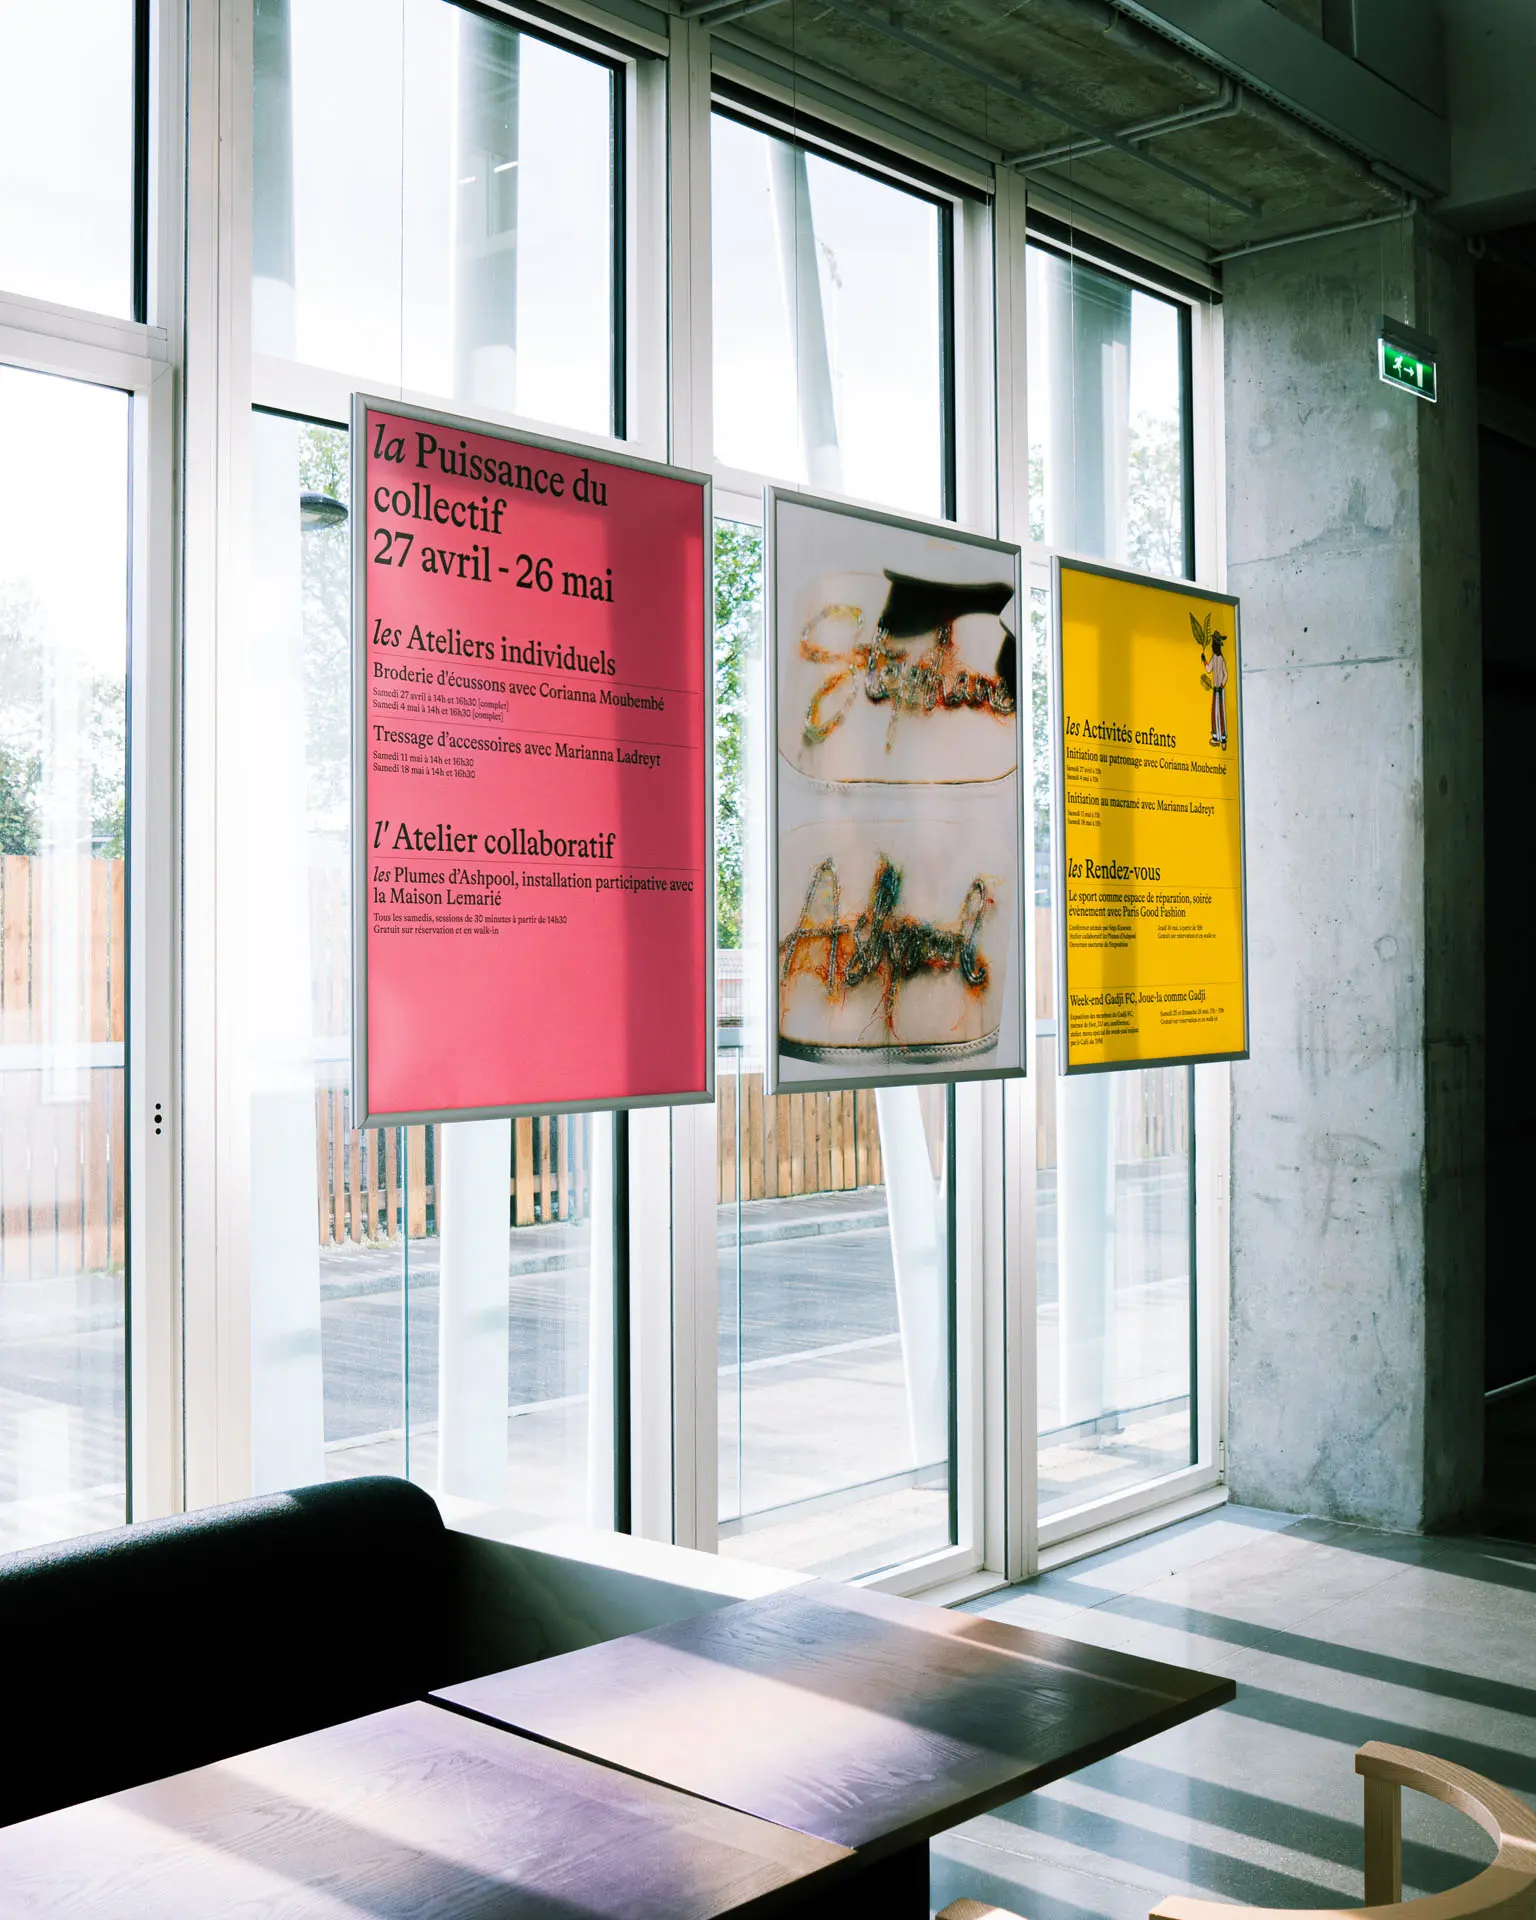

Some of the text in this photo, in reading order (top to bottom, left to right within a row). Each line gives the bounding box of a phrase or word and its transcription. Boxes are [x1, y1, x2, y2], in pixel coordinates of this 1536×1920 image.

[373, 424, 607, 506] la Puissance du
[374, 482, 507, 534] collectif
[374, 529, 614, 602] 27 avril - 26 mai
[373, 619, 616, 676] les Ateliers individuels
[374, 662, 664, 711] Broderie d'écussons avec Corianna Moubembé
[373, 687, 398, 698] Samedi
[410, 692, 426, 701] avril
[428, 693, 431, 701] à
[434, 694, 445, 703] 14h
[456, 697, 476, 706] 16h30
[478, 698, 509, 711] [complet]
[373, 699, 398, 710] Samedi
[407, 704, 420, 712] mai
[427, 705, 440, 714] 14h
[450, 708, 471, 717] 16h30
[473, 709, 503, 722] [complet]
[1066, 717, 1176, 748] les Activités enfants
[373, 751, 399, 760] Samedi
[410, 754, 422, 762] mai
[424, 755, 428, 763] à
[430, 756, 442, 764] 14h
[453, 758, 474, 766] 16h30
[374, 725, 660, 769] Tressage d’accessoires avec Marianna Ladreyt
[373, 763, 399, 773] Samedi
[412, 766, 424, 775] mai
[426, 767, 430, 775] à
[432, 768, 444, 776] 14h
[455, 769, 475, 778] 16h30
[1067, 747, 1226, 775] Initiation au patronage avec Corianna Moubembé
[1068, 792, 1215, 816] Initiation au macramé avec Marianna Ladreyt
[374, 820, 616, 859] l' Atelier collaboratif
[374, 867, 694, 892] les Plumes d’Ashpool, installation participative avec
[1068, 858, 1160, 881] les Rendez-vous
[374, 887, 501, 906] la Maison Lemarié
[1069, 890, 1077, 901] Le
[1079, 892, 1097, 904] sport
[1124, 895, 1145, 905] espace
[1147, 893, 1154, 902] de
[1156, 893, 1191, 905] réparation,
[1193, 894, 1212, 904] soirée
[374, 913, 391, 922] Tous
[393, 914, 402, 922] les
[404, 914, 434, 923] samedis,
[436, 915, 463, 923] sessions
[465, 915, 473, 923] de
[474, 915, 483, 923] 30
[485, 915, 511, 923] minutes
[513, 915, 516, 923] à
[518, 916, 536, 925] partir
[1108, 907, 1121, 917] avec
[1123, 906, 1139, 917] Paris
[1141, 906, 1158, 917] Good
[1160, 906, 1186, 917] Fashion
[374, 925, 399, 934] Gratuit
[415, 926, 454, 934] réservation
[474, 926, 499, 935] walk-in
[1070, 990, 1205, 1007] Week-end Gadji FC, Joue-la comme Gadji
